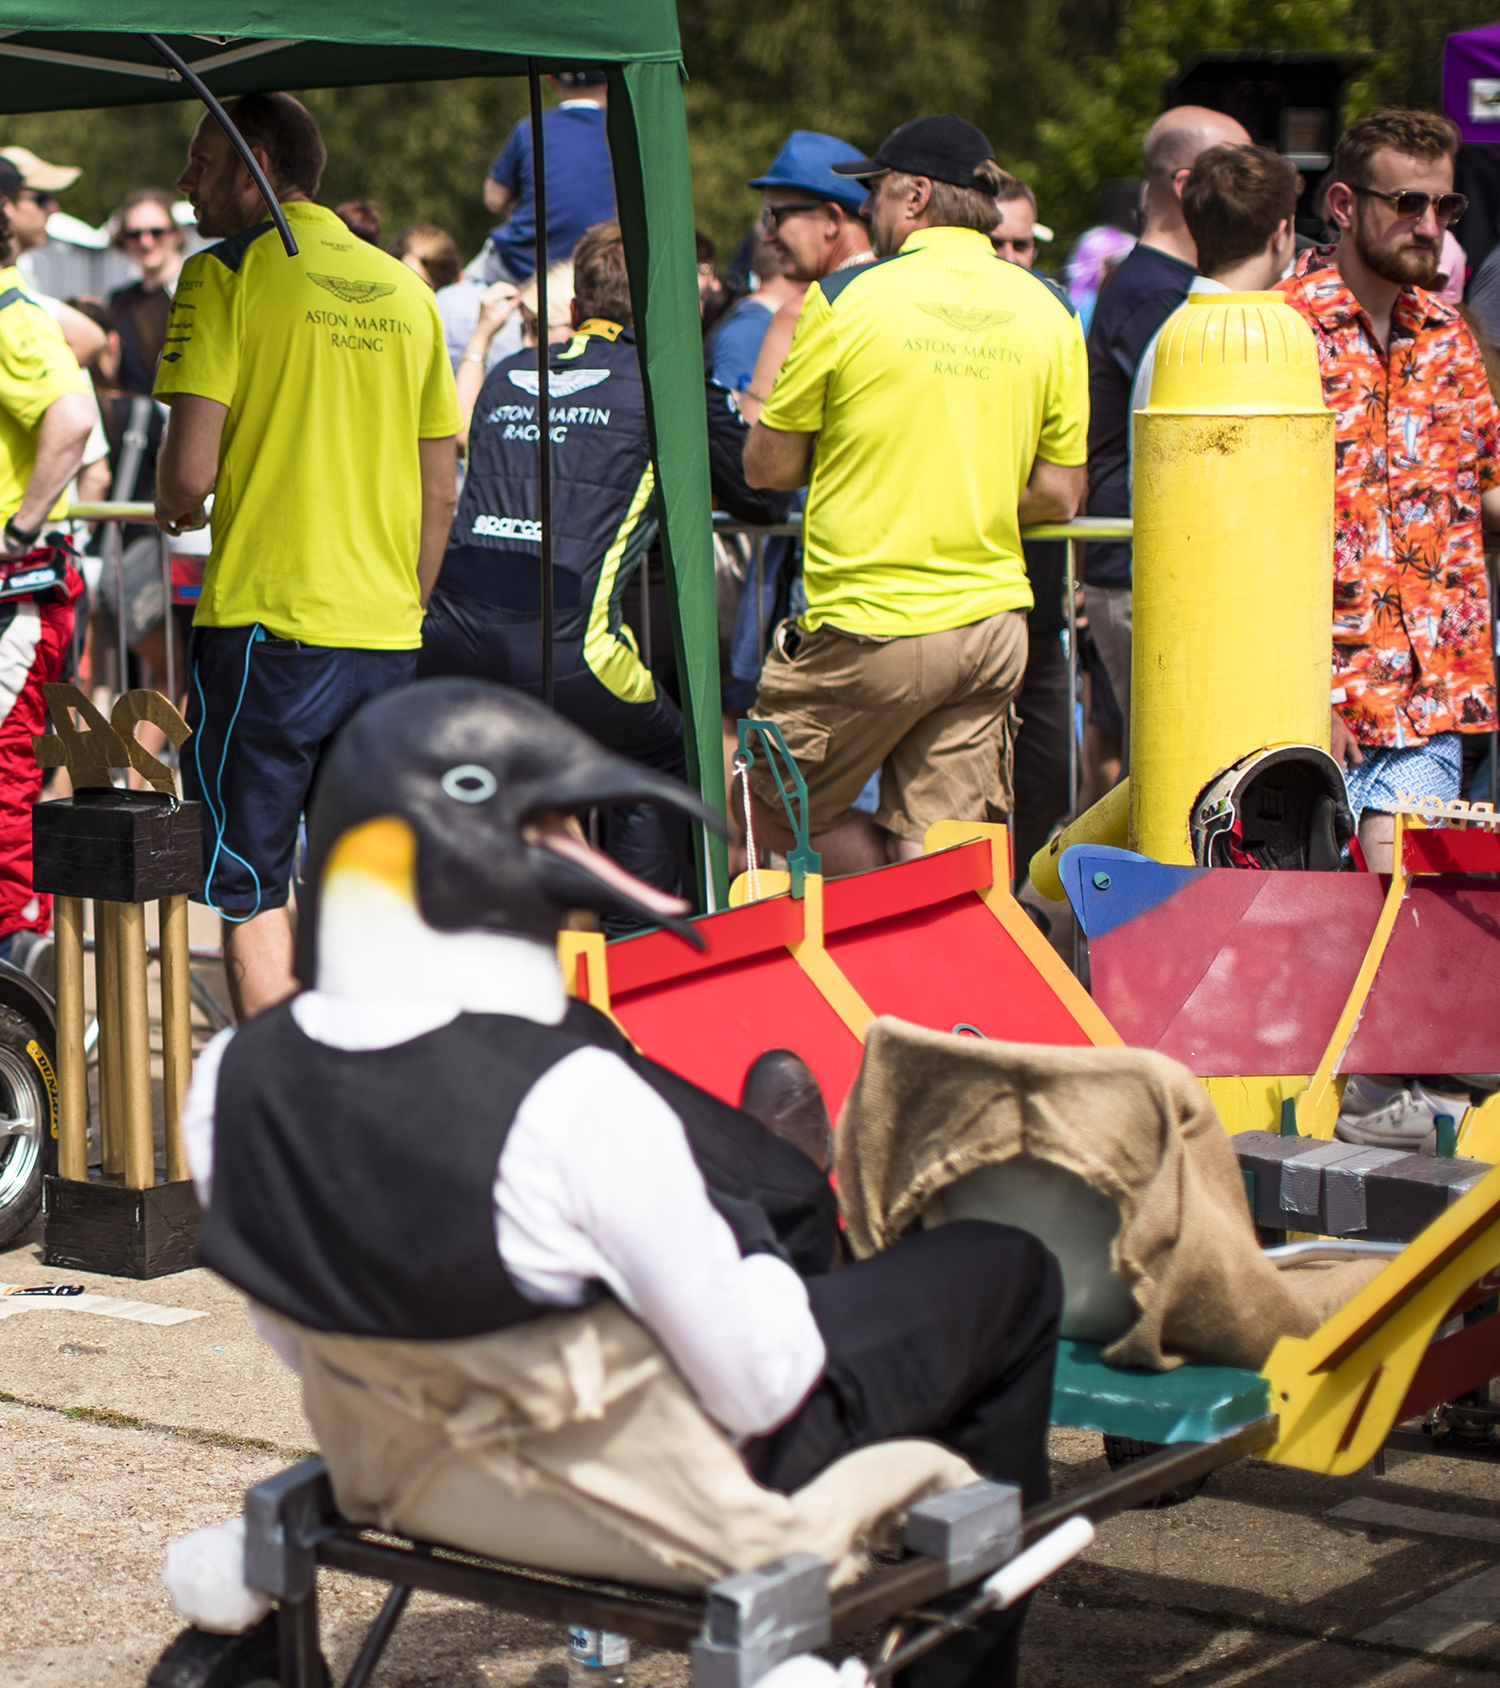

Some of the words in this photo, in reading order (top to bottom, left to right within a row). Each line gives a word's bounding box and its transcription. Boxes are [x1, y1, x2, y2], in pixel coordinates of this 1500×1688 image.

[305, 310, 348, 328] ASTON
[354, 316, 412, 335] MARTIN
[331, 333, 384, 353] RACING
[902, 338, 957, 356] ASTON
[963, 346, 1023, 366] MARTIN
[934, 360, 991, 381] RACING
[486, 405, 535, 424] ASTON
